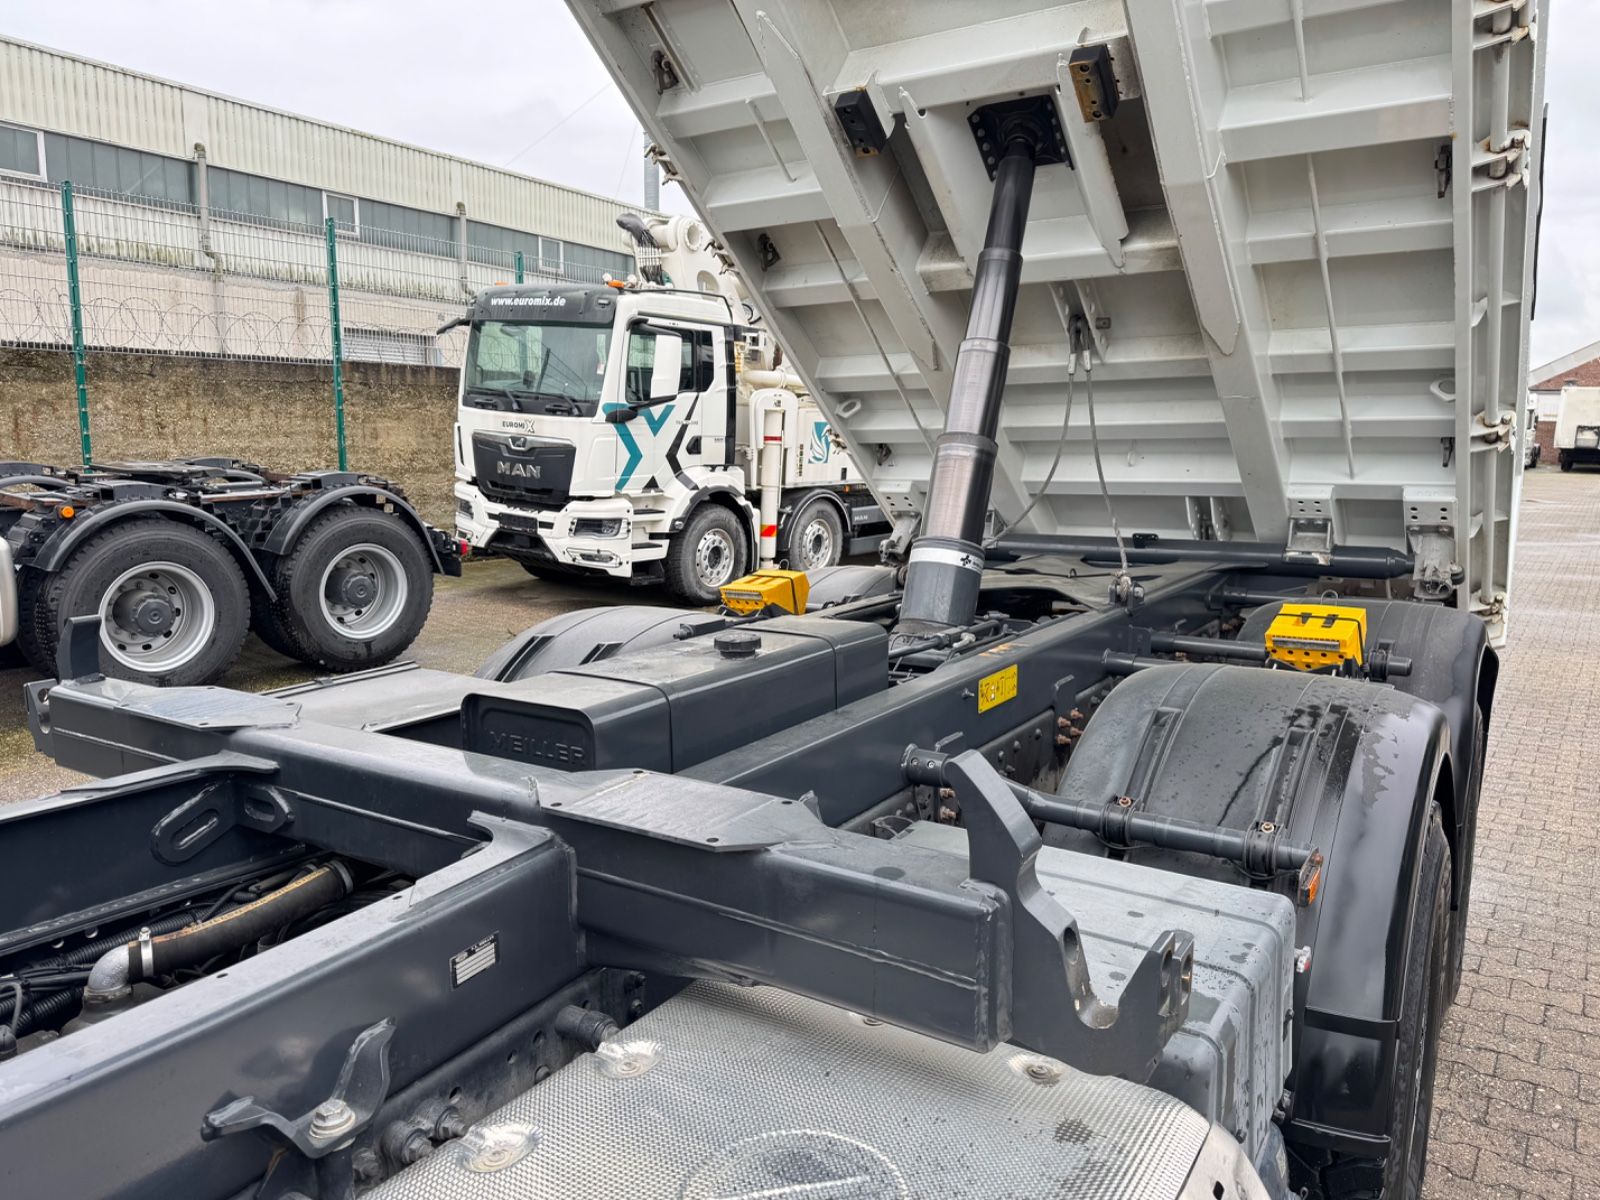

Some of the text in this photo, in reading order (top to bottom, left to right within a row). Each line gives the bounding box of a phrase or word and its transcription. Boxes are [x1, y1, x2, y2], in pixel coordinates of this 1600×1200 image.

[491, 296, 566, 306] www.euromix.de
[496, 460, 541, 479] MAN
[489, 731, 585, 765] MEILLER
